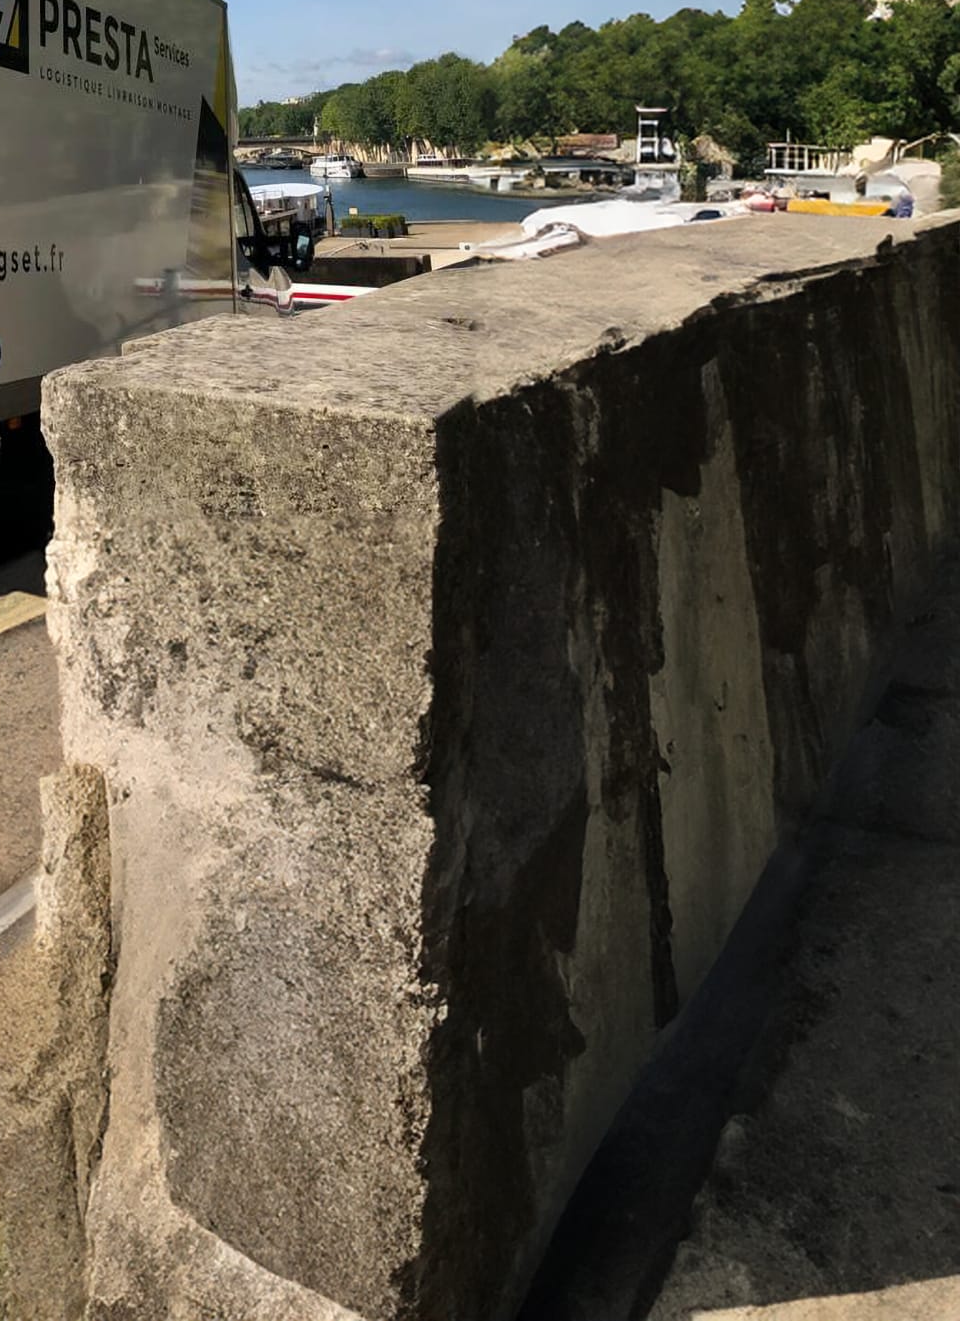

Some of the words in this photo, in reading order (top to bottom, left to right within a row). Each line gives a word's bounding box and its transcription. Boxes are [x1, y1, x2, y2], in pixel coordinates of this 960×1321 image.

[154, 36, 190, 68] Services
[40, 67, 103, 95] LOGISTIQUE
[107, 85, 154, 109] LIVRAISON
[157, 101, 192, 121] MONTAGE
